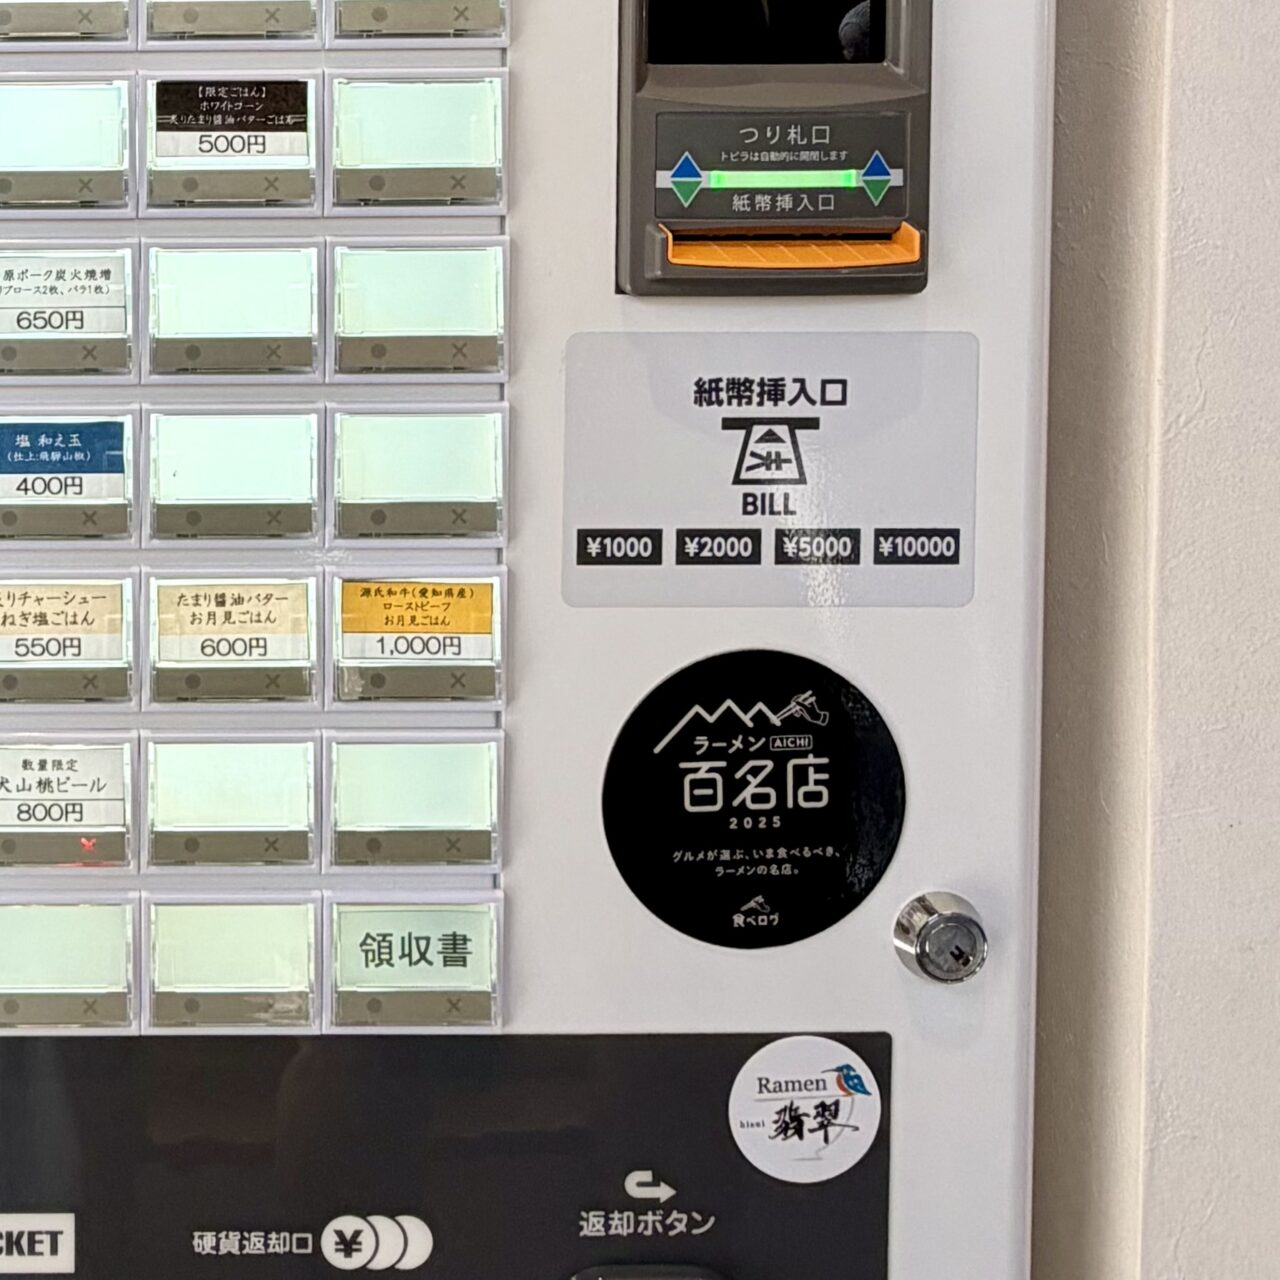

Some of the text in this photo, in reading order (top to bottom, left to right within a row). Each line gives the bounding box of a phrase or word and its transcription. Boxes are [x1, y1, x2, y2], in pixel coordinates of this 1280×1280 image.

[199, 135, 265, 154] 500円
[740, 125, 830, 145] つり札口
[721, 151, 848, 162] トビラは自動的に開閉します
[732, 194, 834, 212] 紙幣挿入口
[17, 310, 84, 331] 650円
[694, 377, 848, 407] 紙幣挿入口
[16, 433, 82, 448] 塩 和え玉
[16, 476, 83, 496] 400円
[741, 493, 797, 516] BILL
[587, 536, 955, 558] ¥1000 ¥2000 ¥5000 ¥10000
[1, 611, 95, 627] ねぎ塩ごはん
[190, 610, 277, 626] お月見ごはん
[14, 637, 81, 658] 550円
[200, 637, 267, 658] 600円
[377, 636, 462, 656] 1,000円
[694, 735, 809, 755] ラーメン AICHI
[22, 759, 79, 772] 数量限定
[679, 753, 829, 812] 百名店
[17, 803, 84, 823] 800円
[730, 817, 781, 829] 2025
[732, 913, 779, 927] 食べログ
[359, 931, 472, 968] 領収書
[757, 1077, 827, 1094] Ramen
[579, 1210, 715, 1236] 返却ボタン
[194, 1231, 312, 1256] 硬貨返却口
